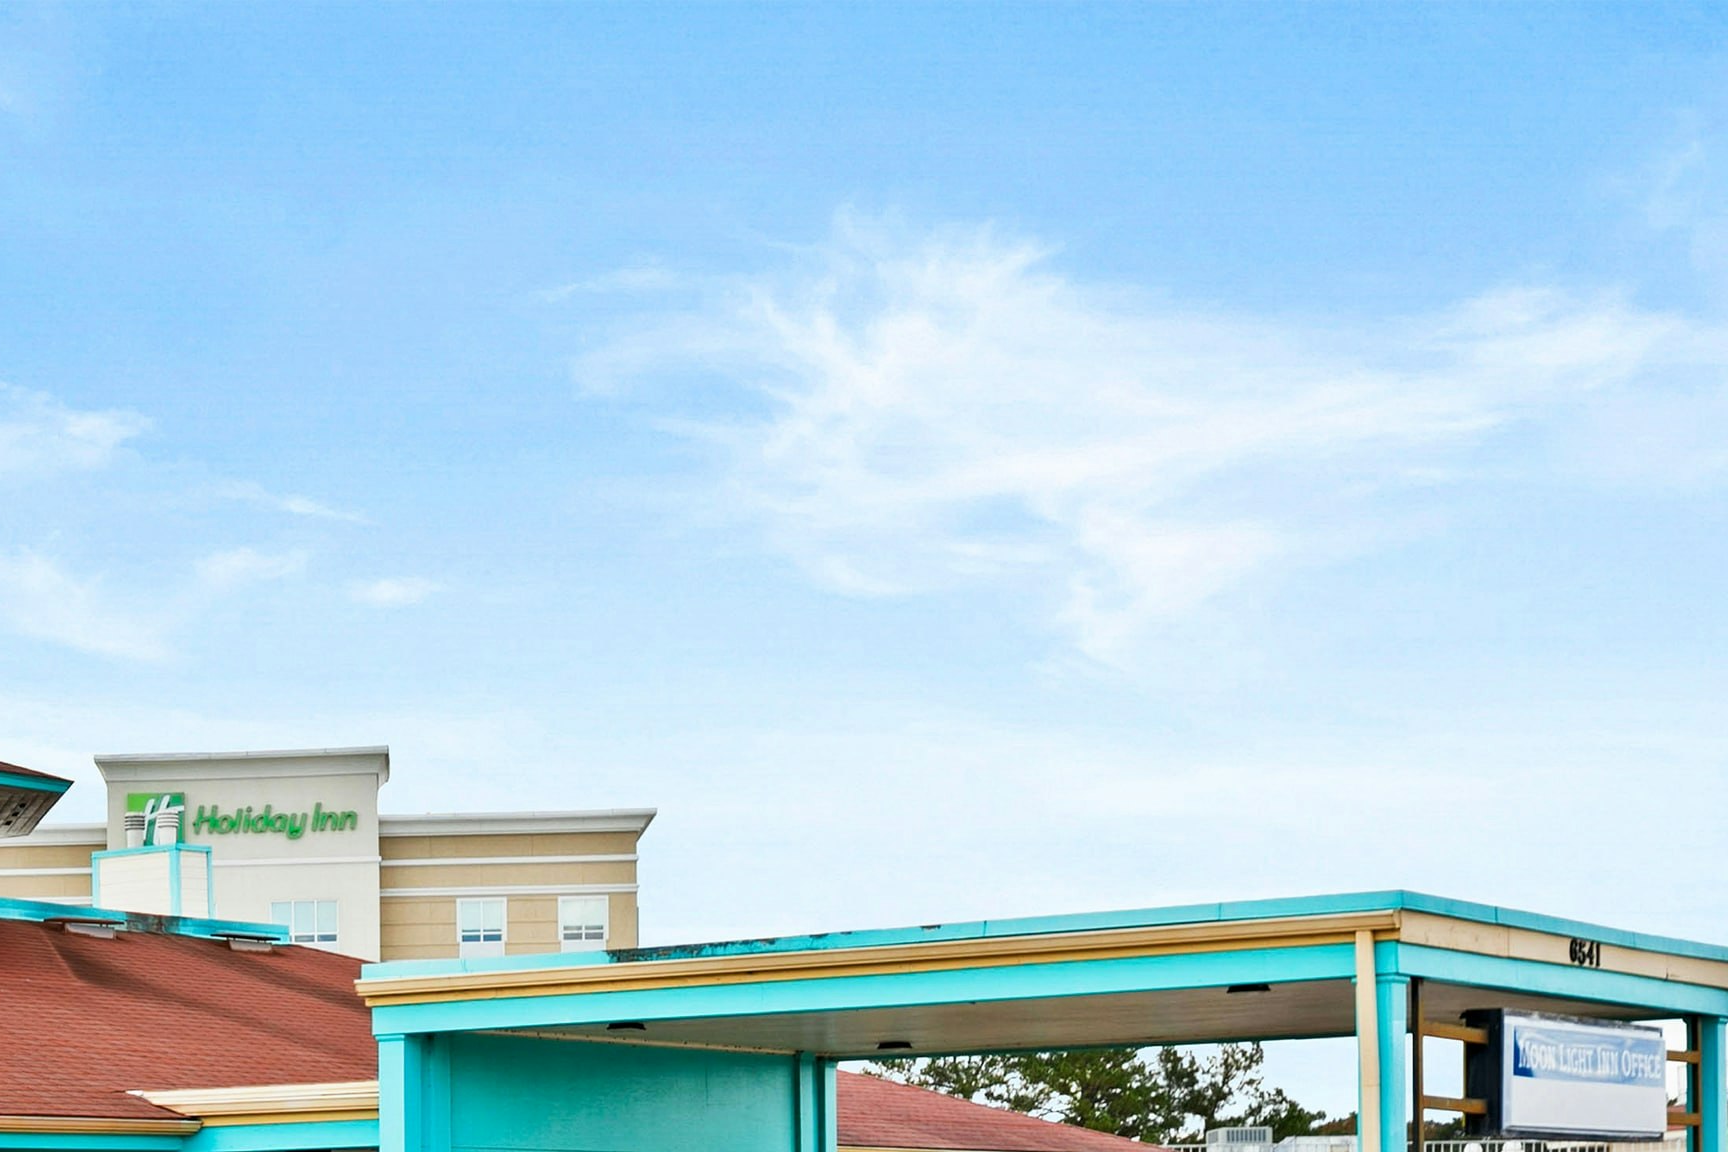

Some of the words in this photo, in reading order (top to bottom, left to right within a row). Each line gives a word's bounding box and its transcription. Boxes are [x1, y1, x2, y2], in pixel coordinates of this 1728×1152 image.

[193, 804, 307, 839] Holiday
[311, 802, 358, 832] Inn
[1518, 1040, 1556, 1070] MOON
[1560, 1044, 1593, 1073] LIGHT
[1596, 1047, 1618, 1075] INN
[1622, 1050, 1661, 1078] OFFICE
